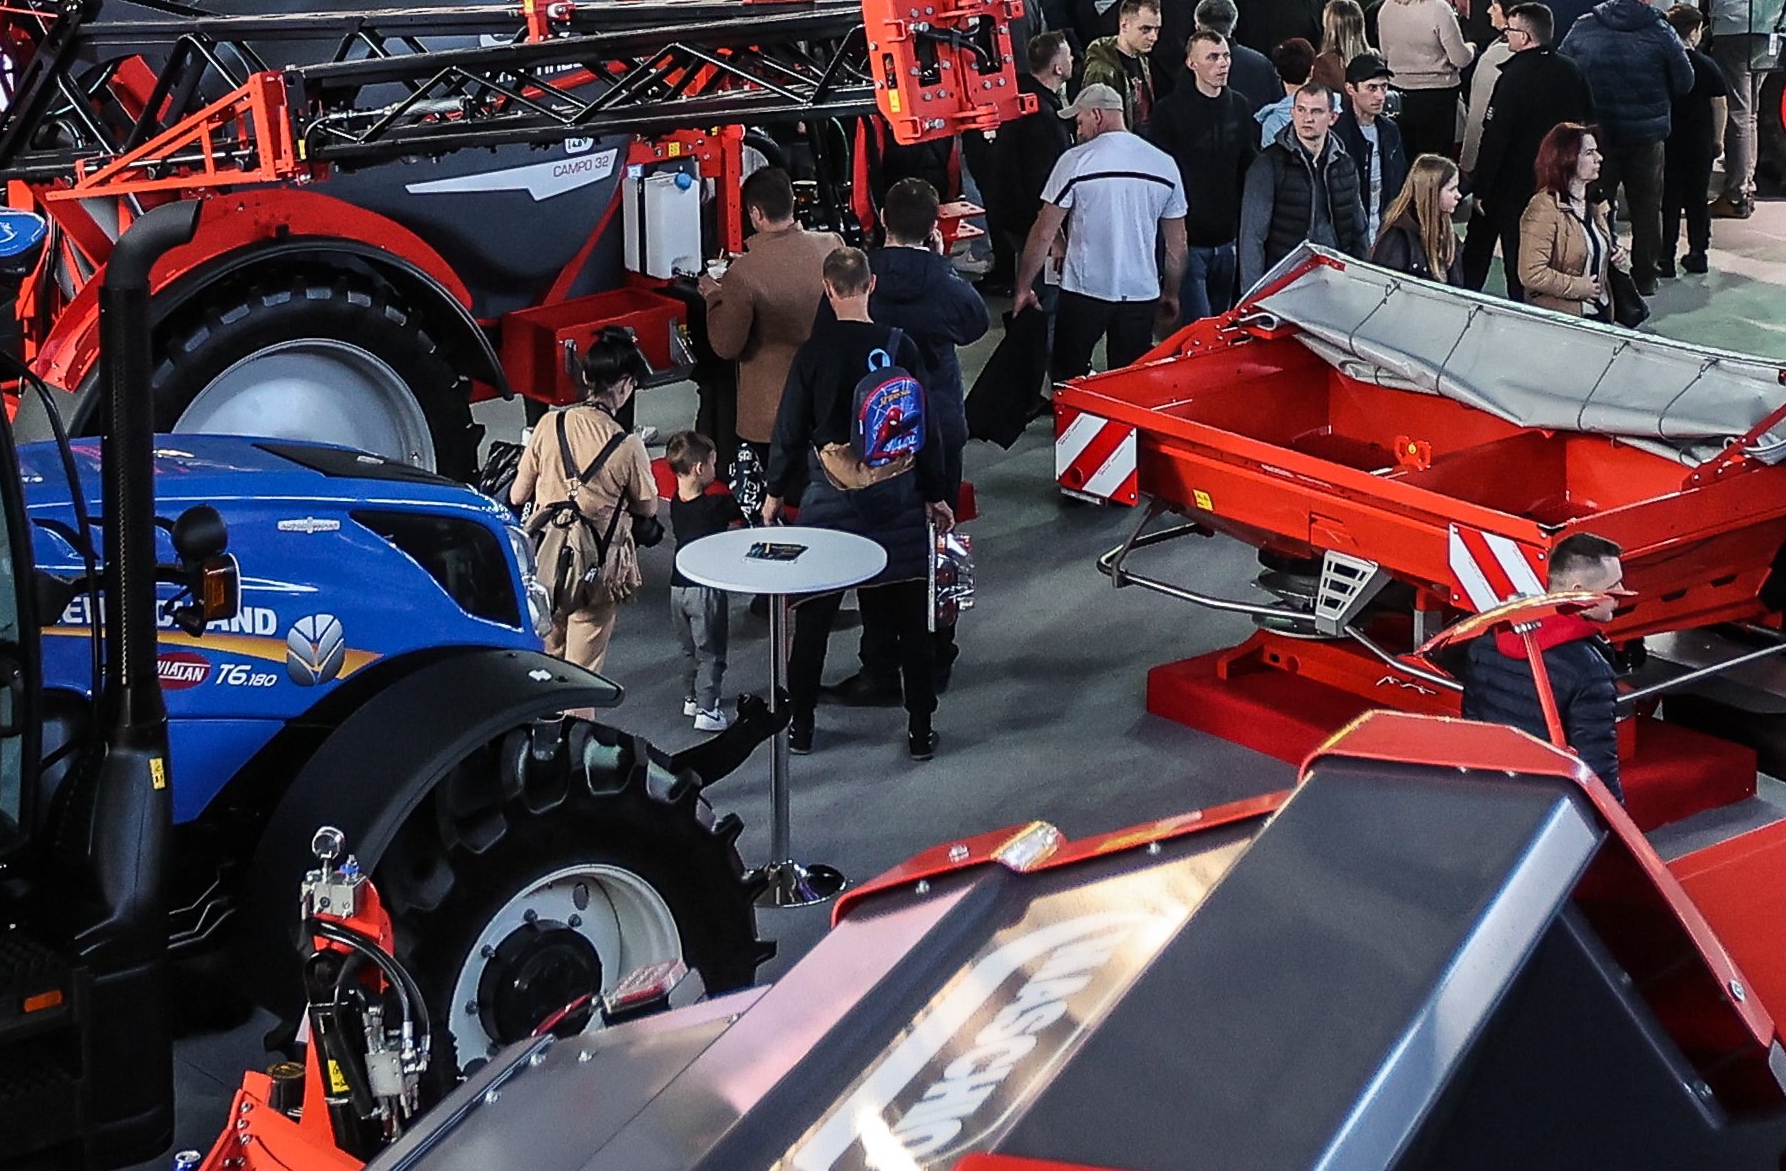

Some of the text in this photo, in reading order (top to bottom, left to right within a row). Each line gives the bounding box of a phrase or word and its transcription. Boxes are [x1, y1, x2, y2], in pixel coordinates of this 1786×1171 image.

[553, 155, 609, 178] CAMPO 32
[215, 662, 278, 689] T6.180
